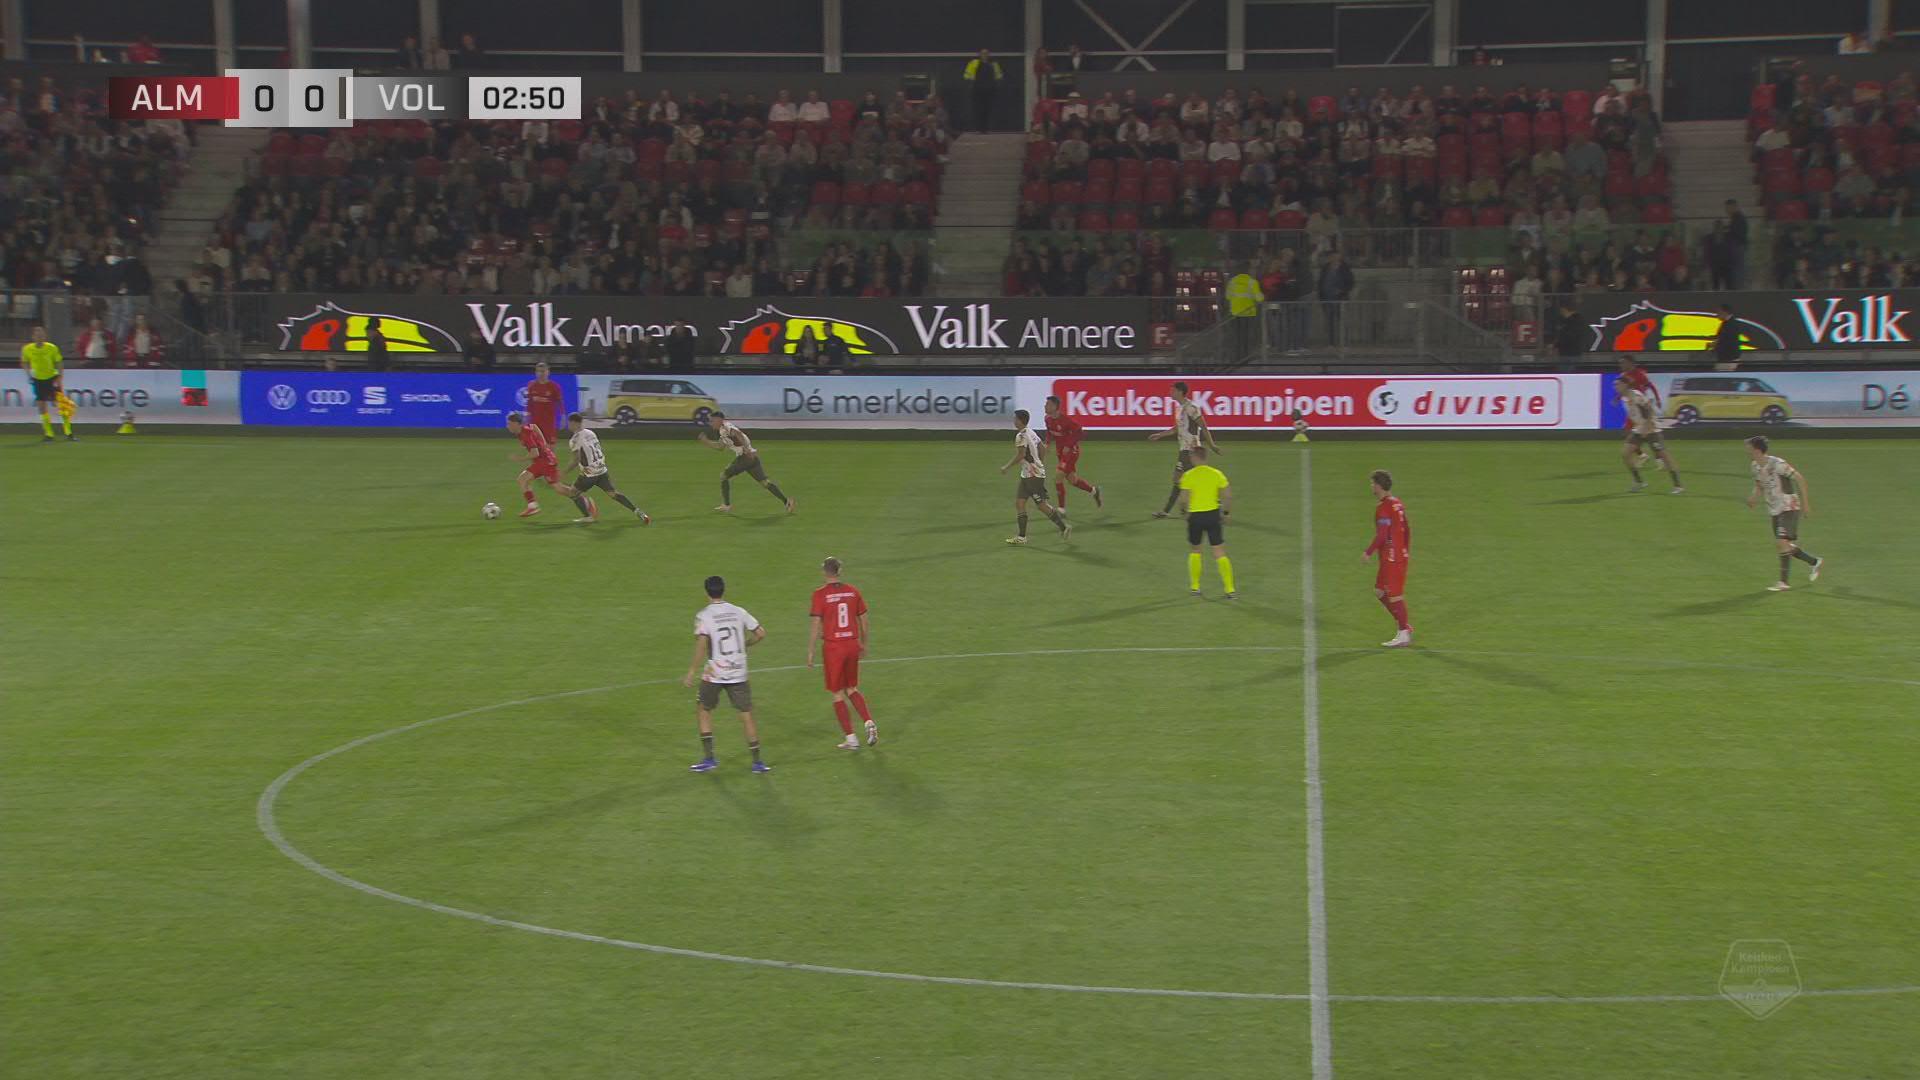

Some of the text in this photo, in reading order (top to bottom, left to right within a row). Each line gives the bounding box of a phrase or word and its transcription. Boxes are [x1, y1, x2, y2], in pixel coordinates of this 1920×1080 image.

[465, 303, 574, 347] Valk
[904, 304, 1136, 350] Valk Almere
[1792, 296, 1911, 344] Valk
[783, 388, 1012, 414] Dé merkdealer
[1192, 388, 1354, 422] Kampioen
[1863, 384, 1909, 411] Dé
[837, 602, 849, 628] 8
[717, 626, 742, 656] 21
